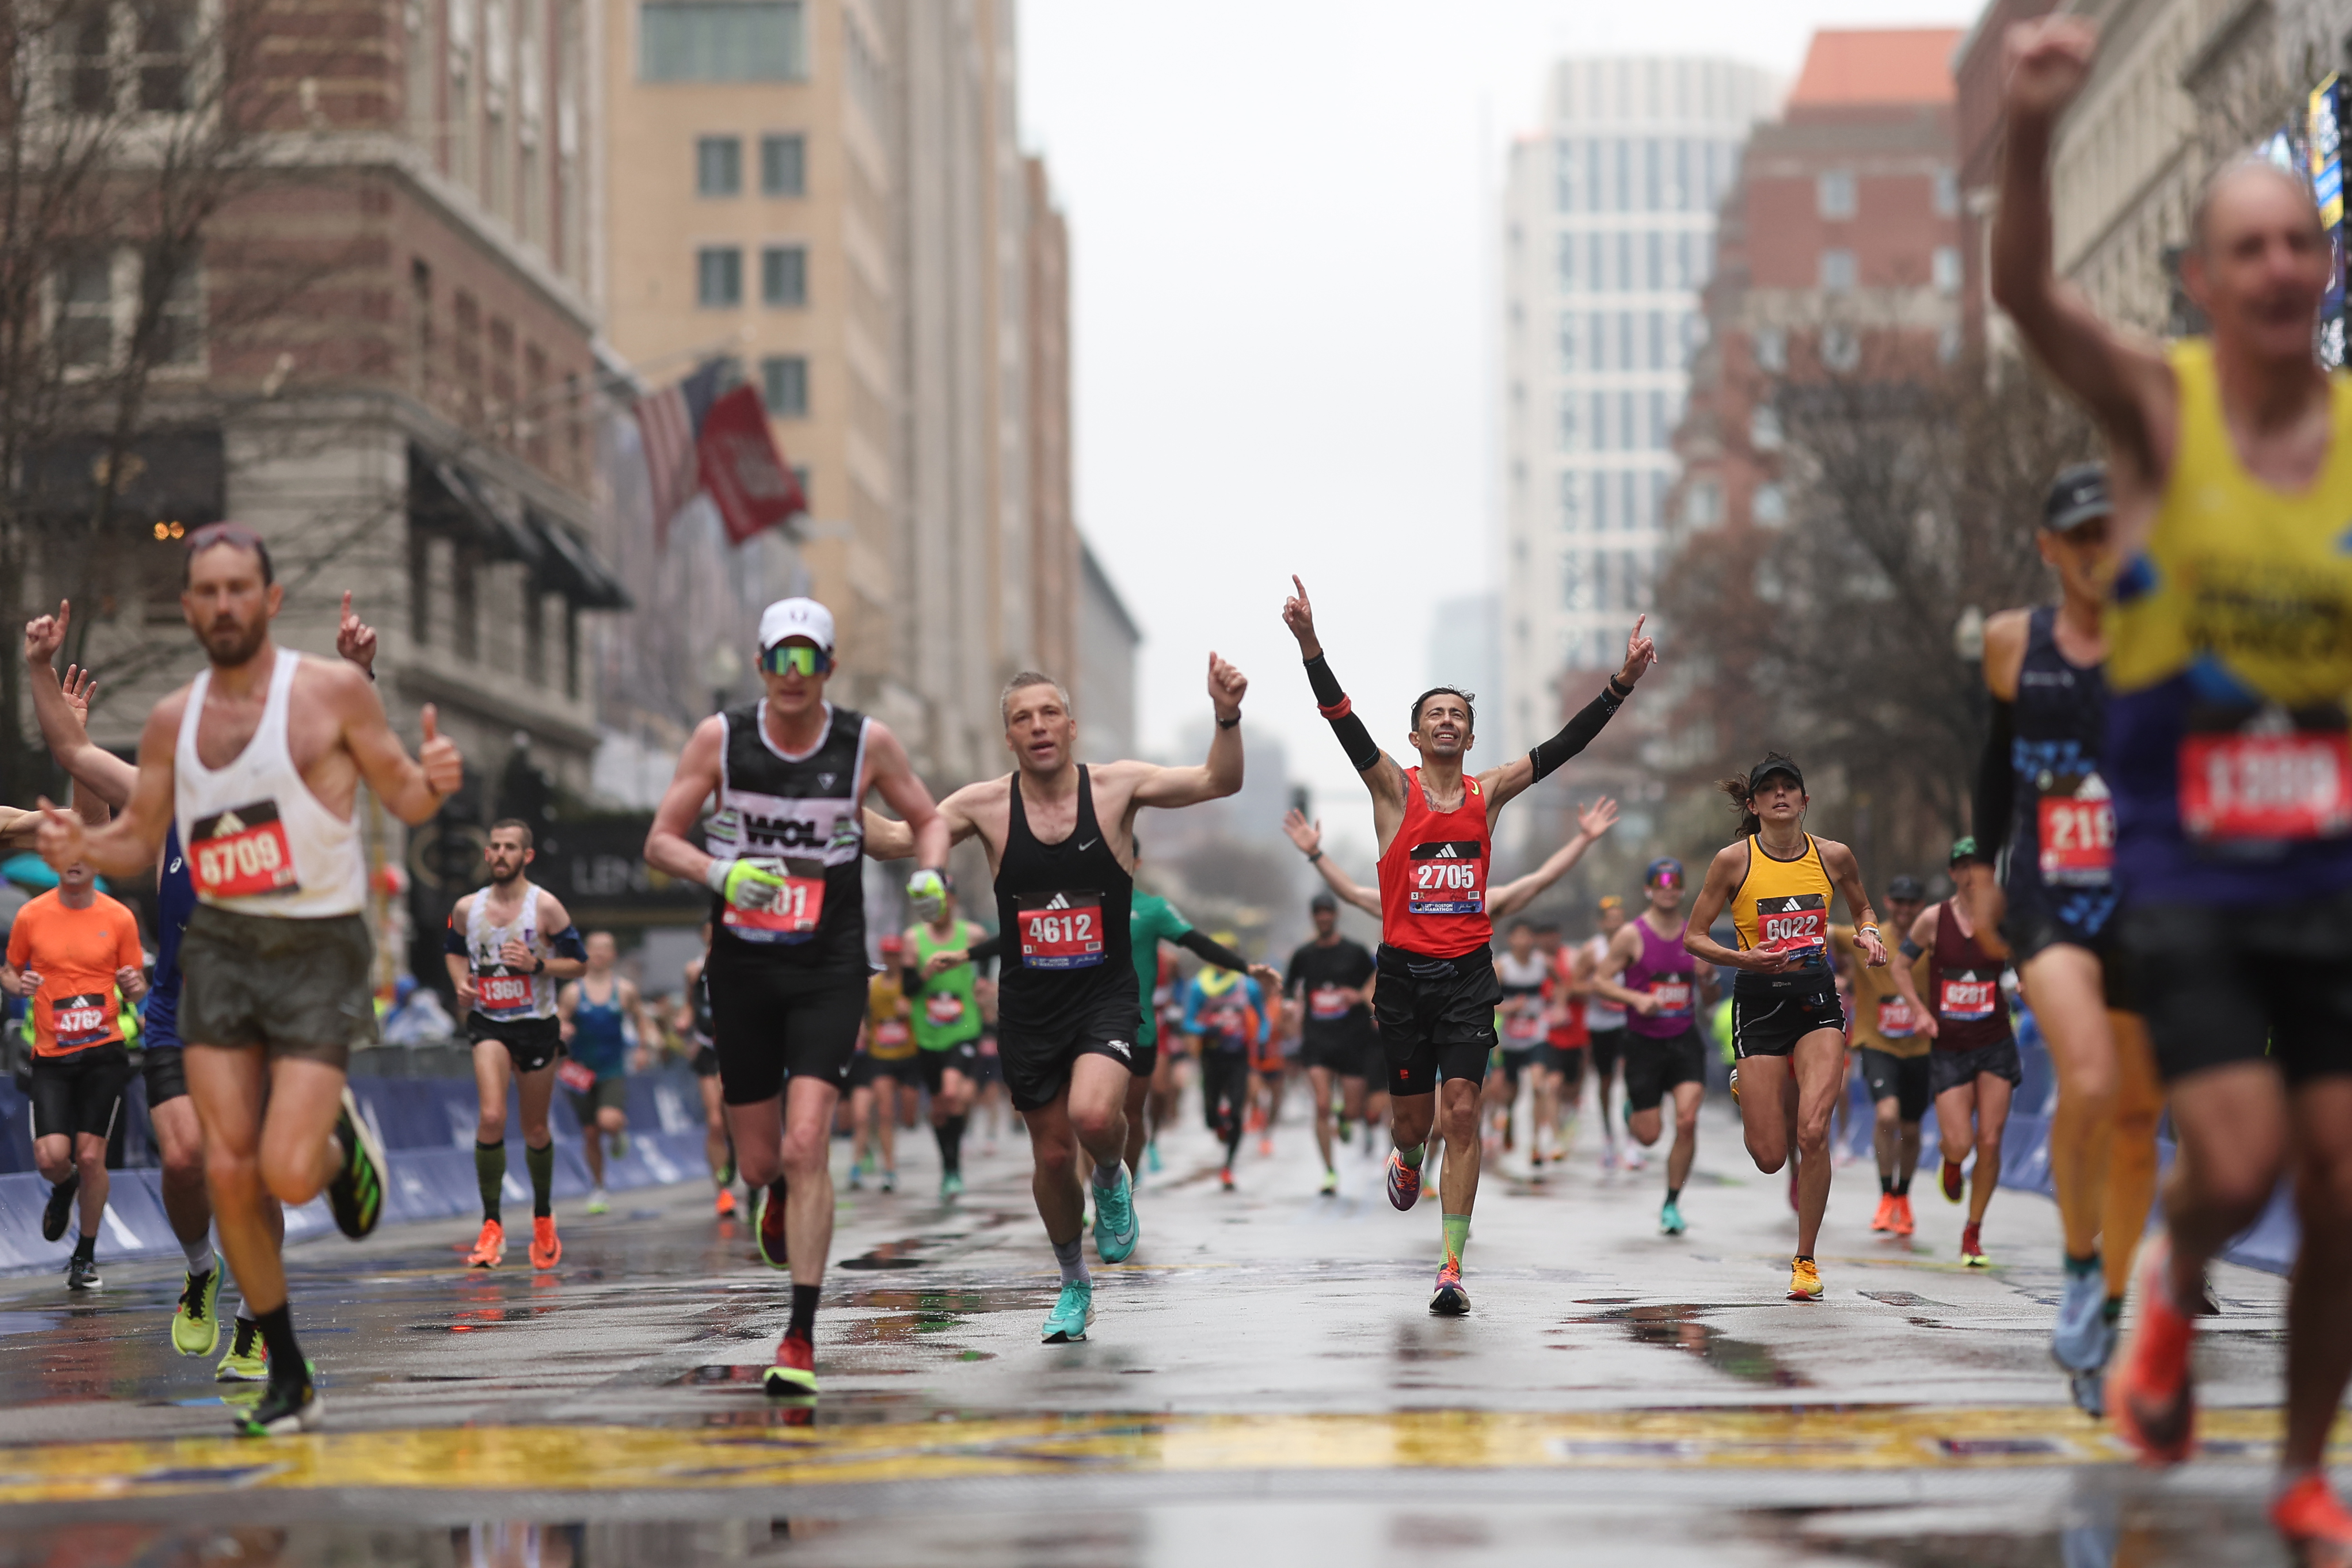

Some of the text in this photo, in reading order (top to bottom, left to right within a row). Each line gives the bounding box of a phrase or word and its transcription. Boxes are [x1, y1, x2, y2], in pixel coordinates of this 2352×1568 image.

[744, 814, 828, 847] WOL
[200, 831, 281, 886] 6709
[1418, 864, 1474, 889] 2705
[762, 884, 807, 918] 01
[1029, 914, 1093, 943] 4612
[1767, 915, 1818, 940] 6022
[483, 979, 524, 1000] 1360
